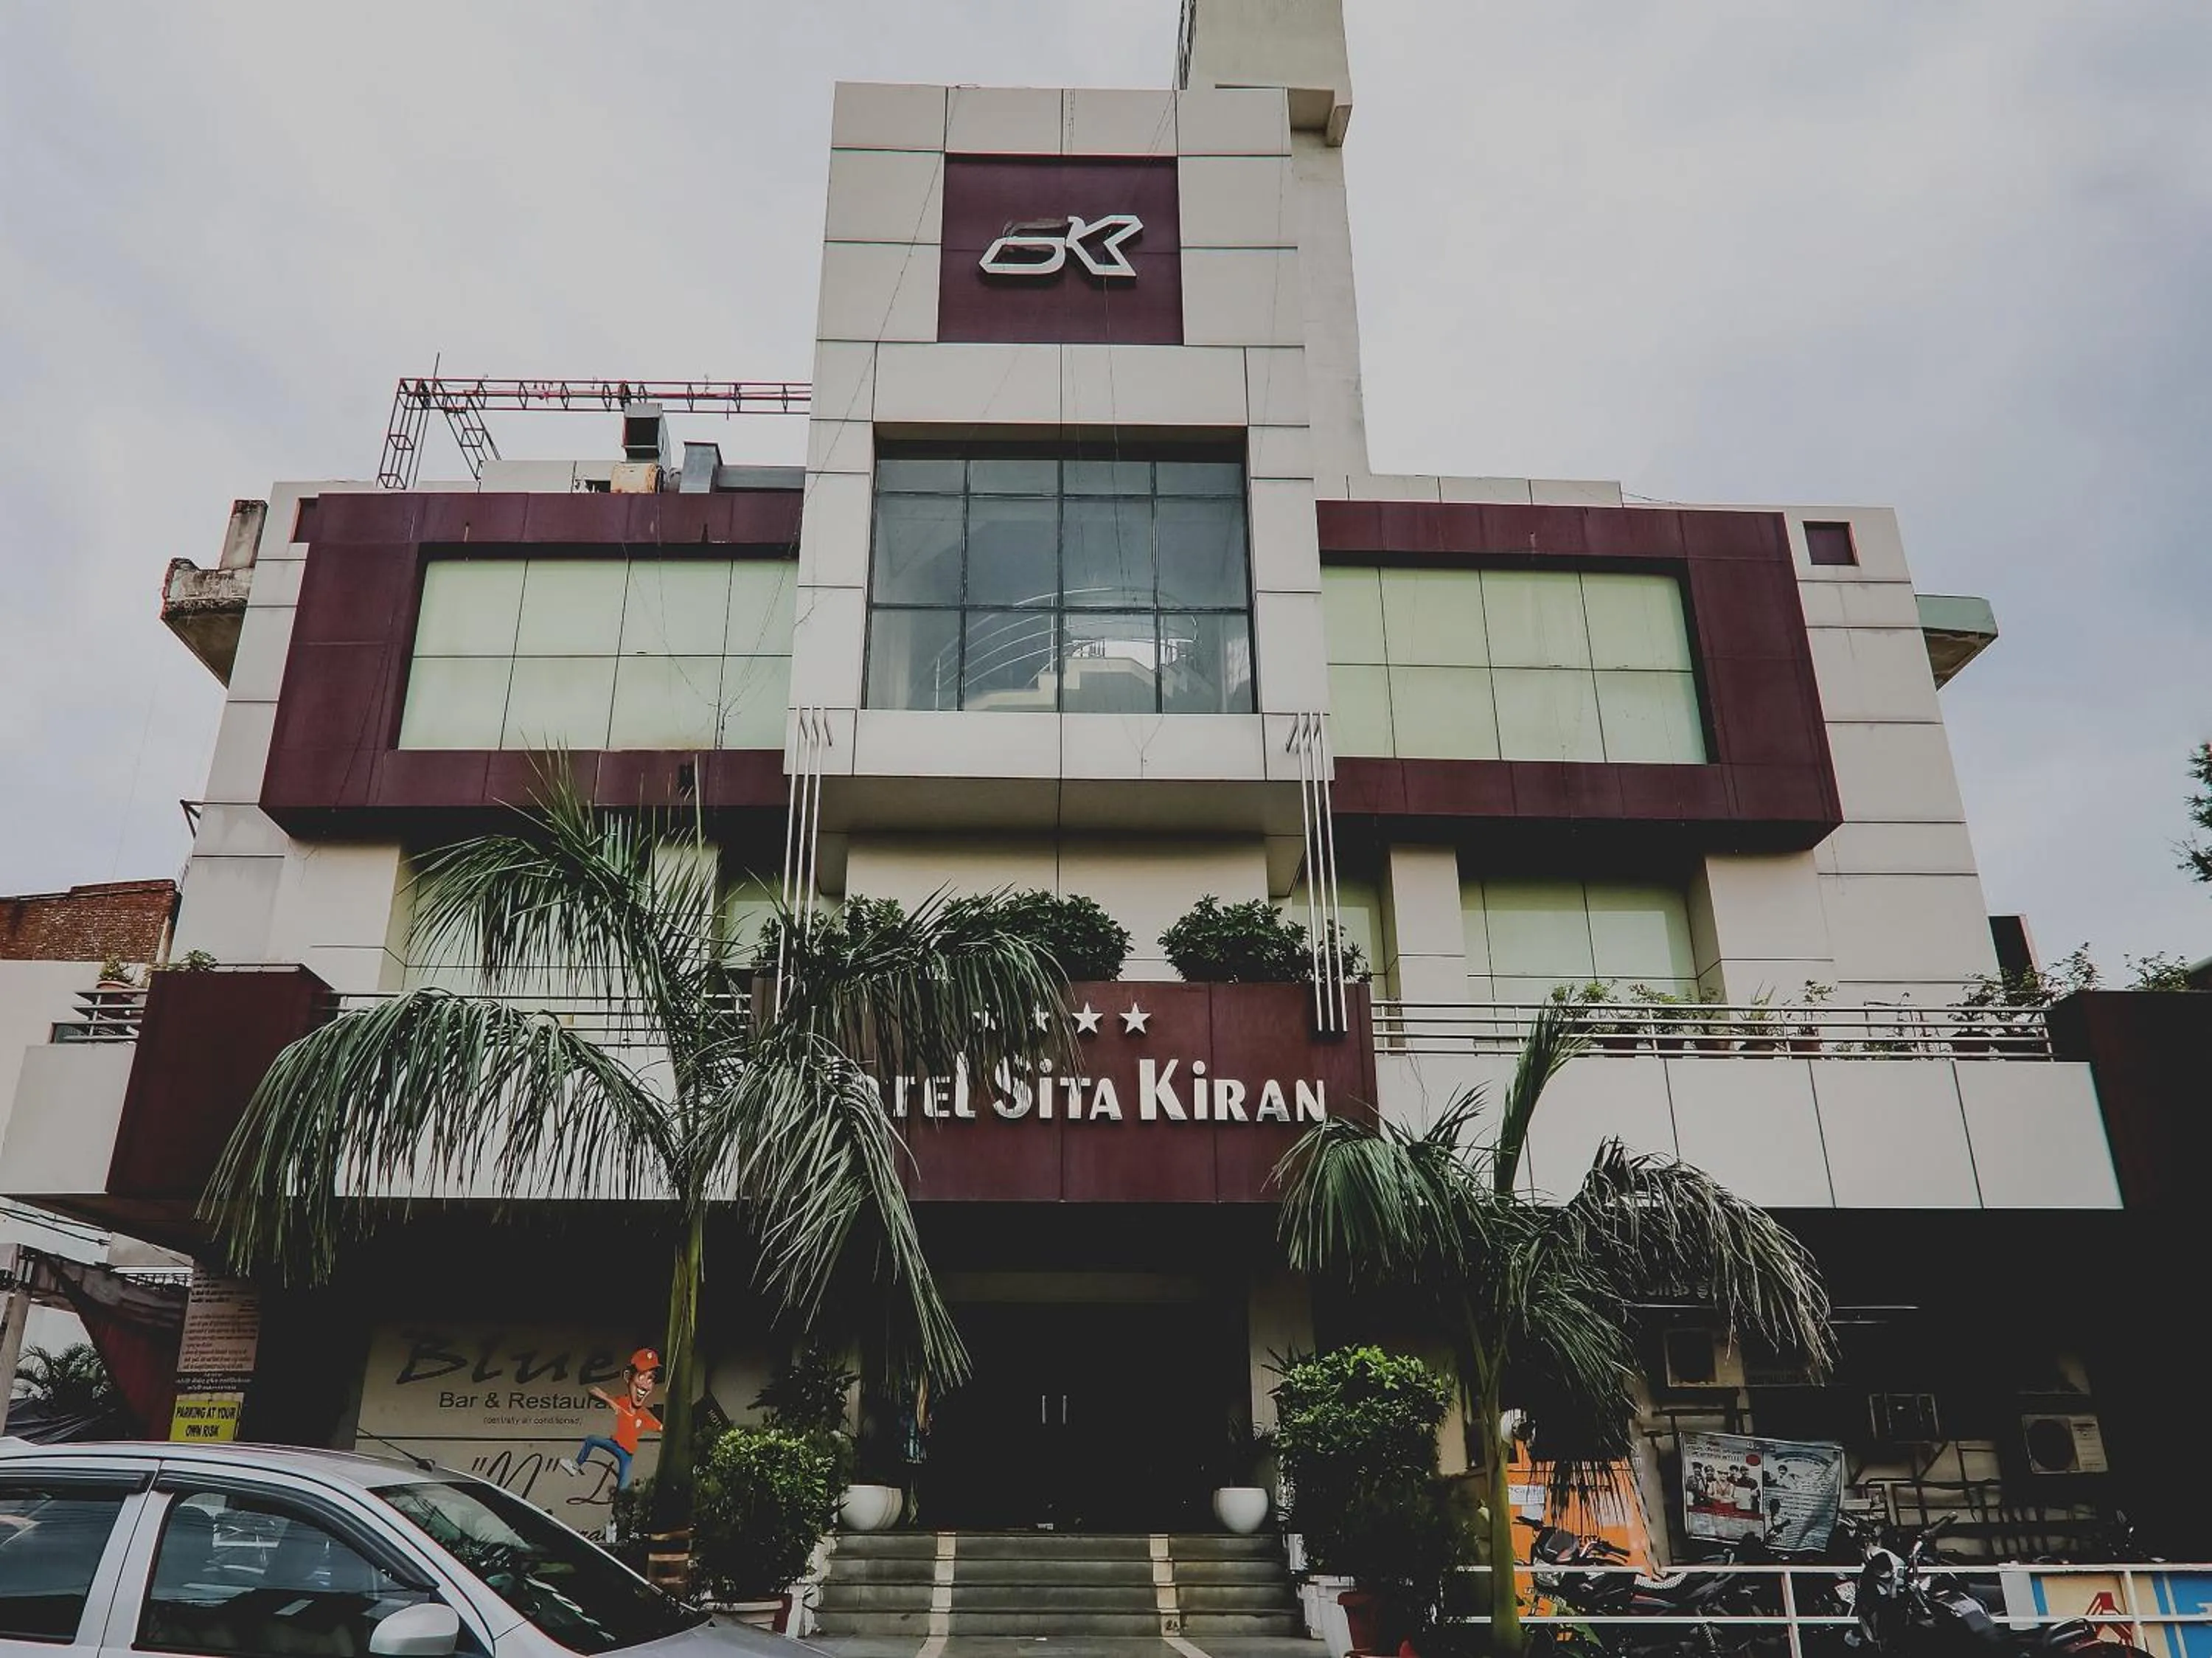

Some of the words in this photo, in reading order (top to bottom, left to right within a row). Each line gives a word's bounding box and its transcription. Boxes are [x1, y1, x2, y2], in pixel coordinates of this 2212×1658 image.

[439, 1392, 478, 1409] Bar
[484, 1392, 500, 1409] &
[509, 1392, 614, 1409] Restaura
